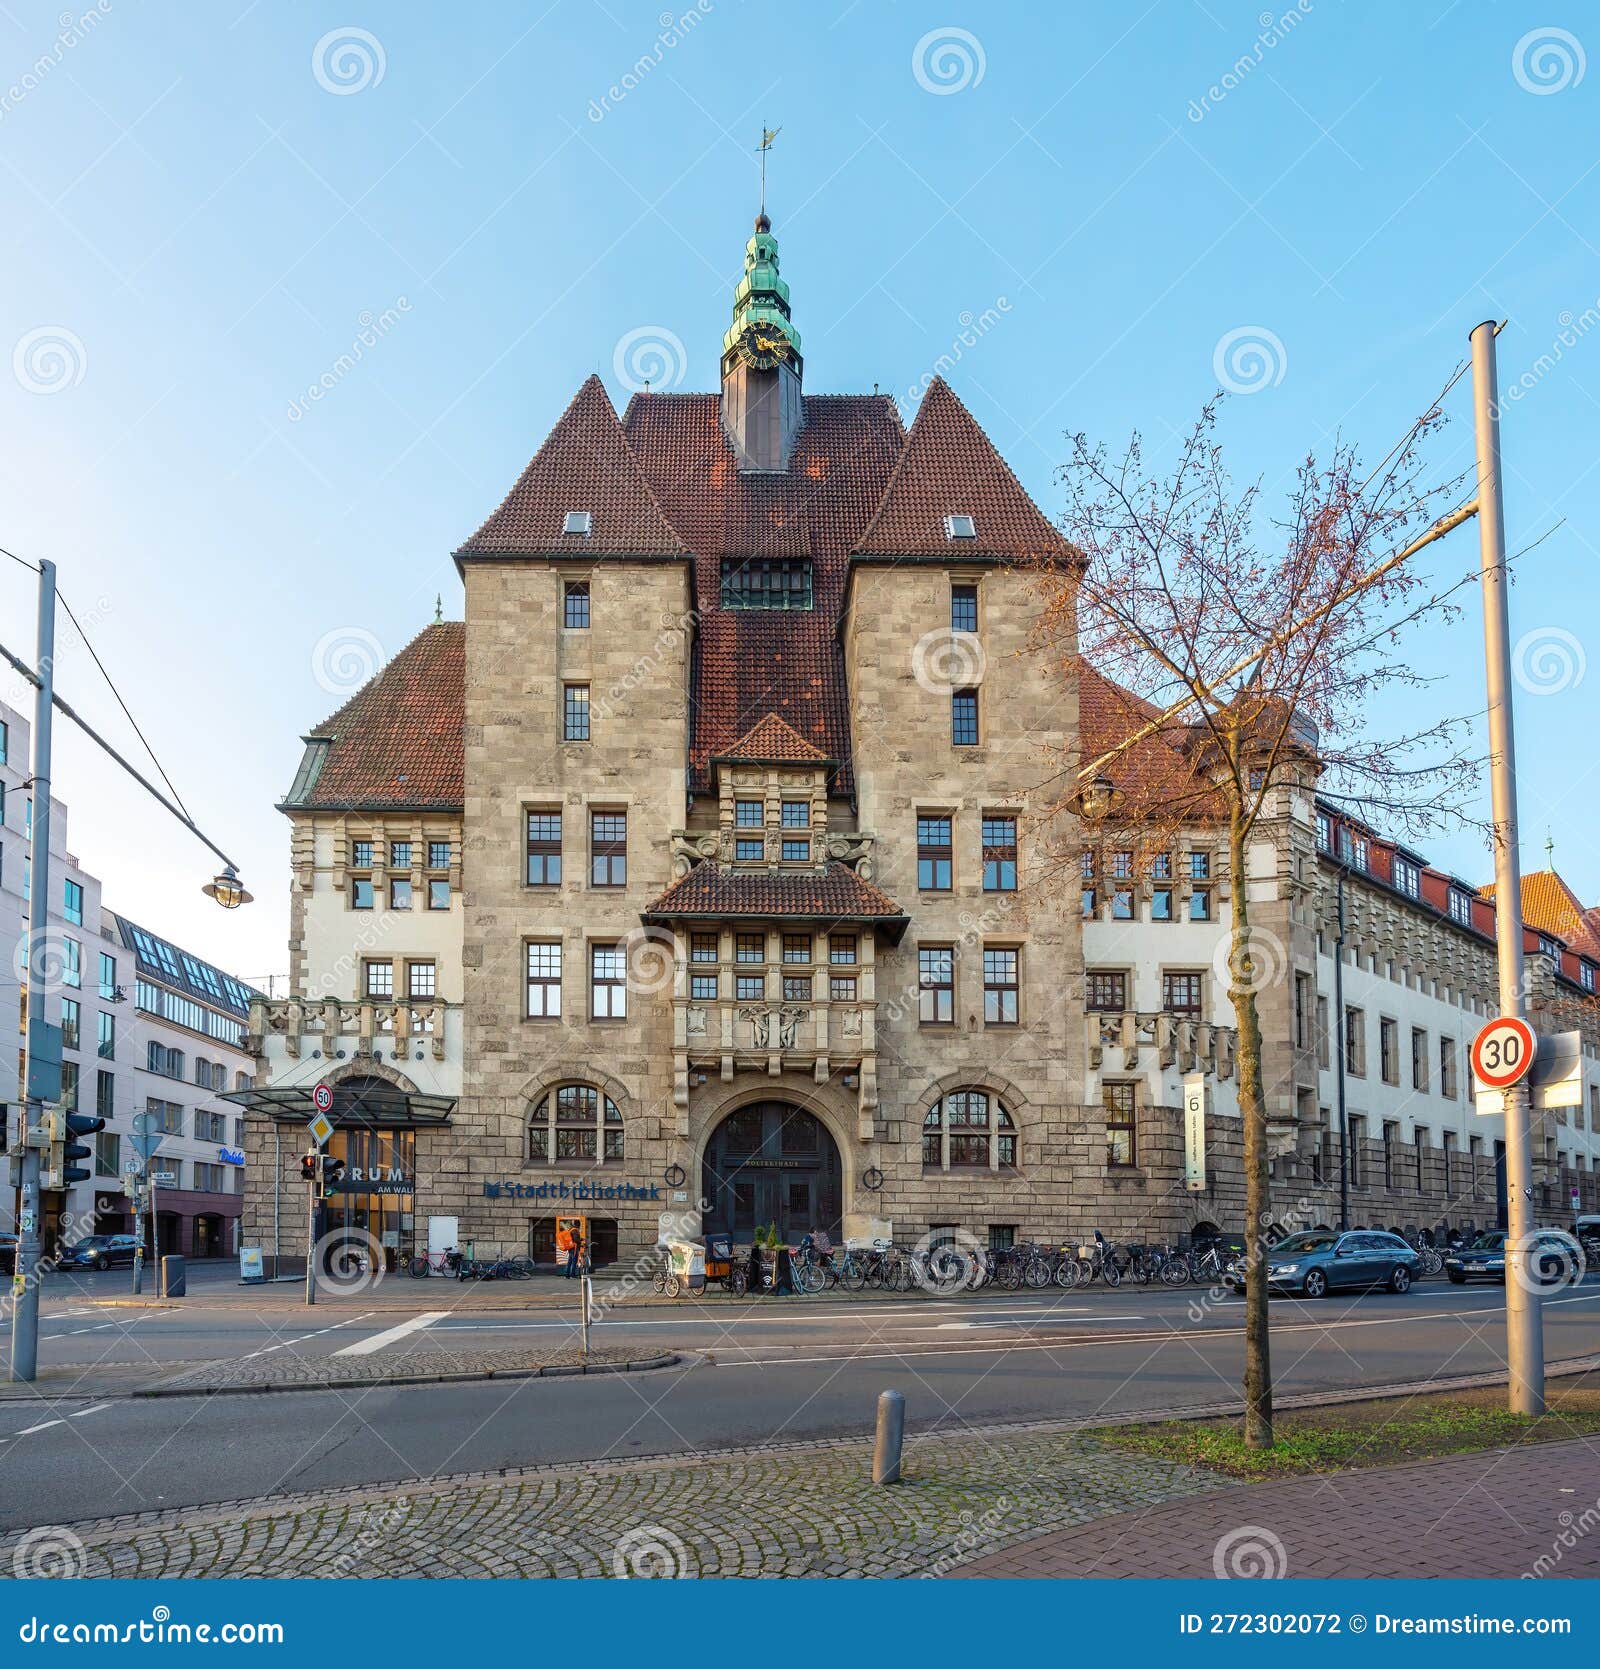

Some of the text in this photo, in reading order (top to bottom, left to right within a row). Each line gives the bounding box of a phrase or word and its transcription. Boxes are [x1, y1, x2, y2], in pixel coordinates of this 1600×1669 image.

[1485, 1036, 1519, 1069] 30
[318, 1092, 329, 1104] 50
[1190, 1097, 1199, 1111] 6
[504, 1181, 660, 1200] Stadtbibliothek
